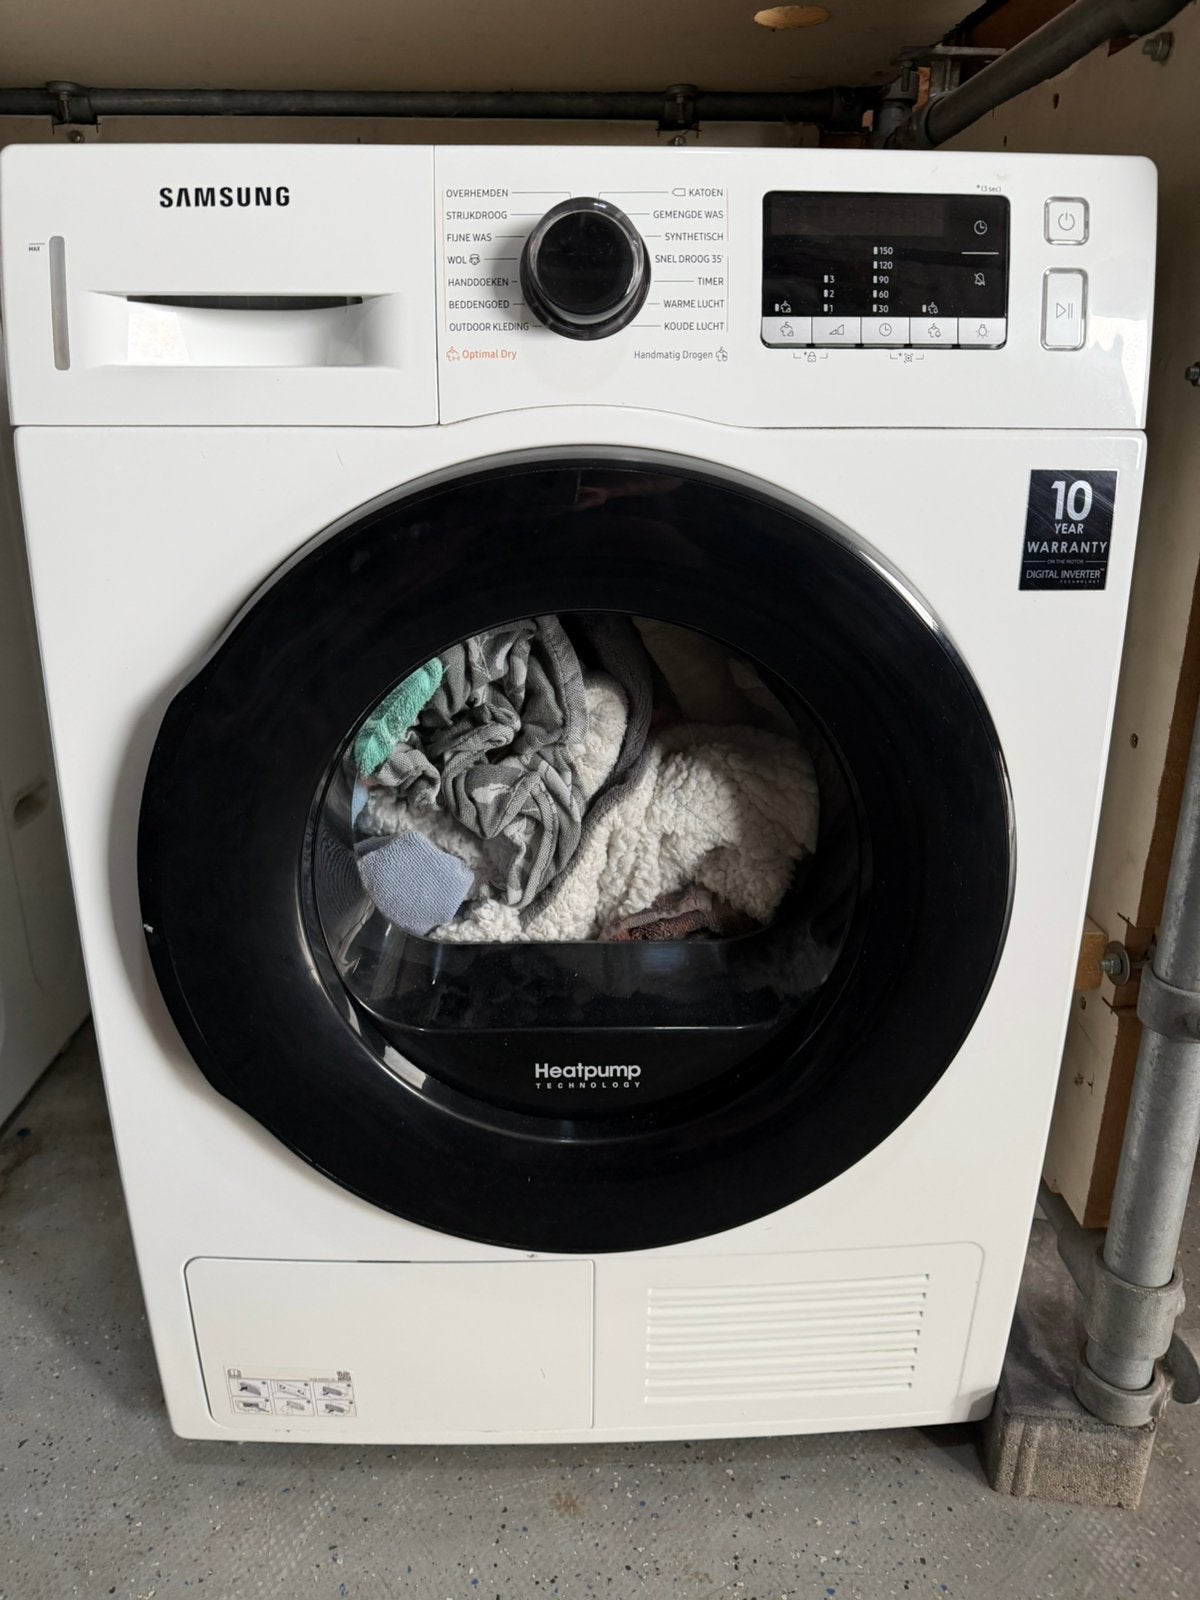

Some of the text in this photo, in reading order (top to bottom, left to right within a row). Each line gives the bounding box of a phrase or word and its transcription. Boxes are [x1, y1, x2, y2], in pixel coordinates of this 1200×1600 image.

[159, 186, 290, 208] SAMSUNG
[446, 188, 508, 198] OVERHEMDEN
[689, 188, 723, 197] KATOEN
[446, 210, 508, 220] STRIJKDROOG
[653, 210, 724, 219] GEMENGDE WAS
[446, 232, 492, 242] FIJNE WAS
[664, 232, 724, 241] SYNTHETISCH
[879, 246, 894, 255] 150
[447, 255, 467, 265] WOL
[655, 254, 677, 264] SNEL
[678, 254, 710, 264] DROOG
[879, 261, 893, 270] 120
[447, 277, 509, 287] HANDDOEKEN
[697, 276, 724, 286] TIMER
[829, 274, 836, 284] 3
[878, 275, 890, 284] 90
[829, 289, 836, 298] 2
[878, 290, 889, 299] 60
[448, 299, 510, 309] BEDDENGOED
[663, 299, 725, 308] WARME LUCHT
[829, 304, 834, 313] 1
[878, 304, 889, 313] 30
[449, 322, 530, 332] OUTDOOR KLEDING
[664, 321, 725, 331] KOUDE LUCHT
[462, 349, 517, 360] Optimal Dry
[634, 350, 713, 361] Handmatig Drogen
[1051, 480, 1092, 520] 10
[1054, 523, 1084, 534] YEAR
[1027, 541, 1108, 554] WARRANTY
[1026, 569, 1101, 579] DIGITAL INVERTER
[534, 1062, 642, 1081] Heatpump
[535, 1082, 641, 1090] TECHNOLOGY
